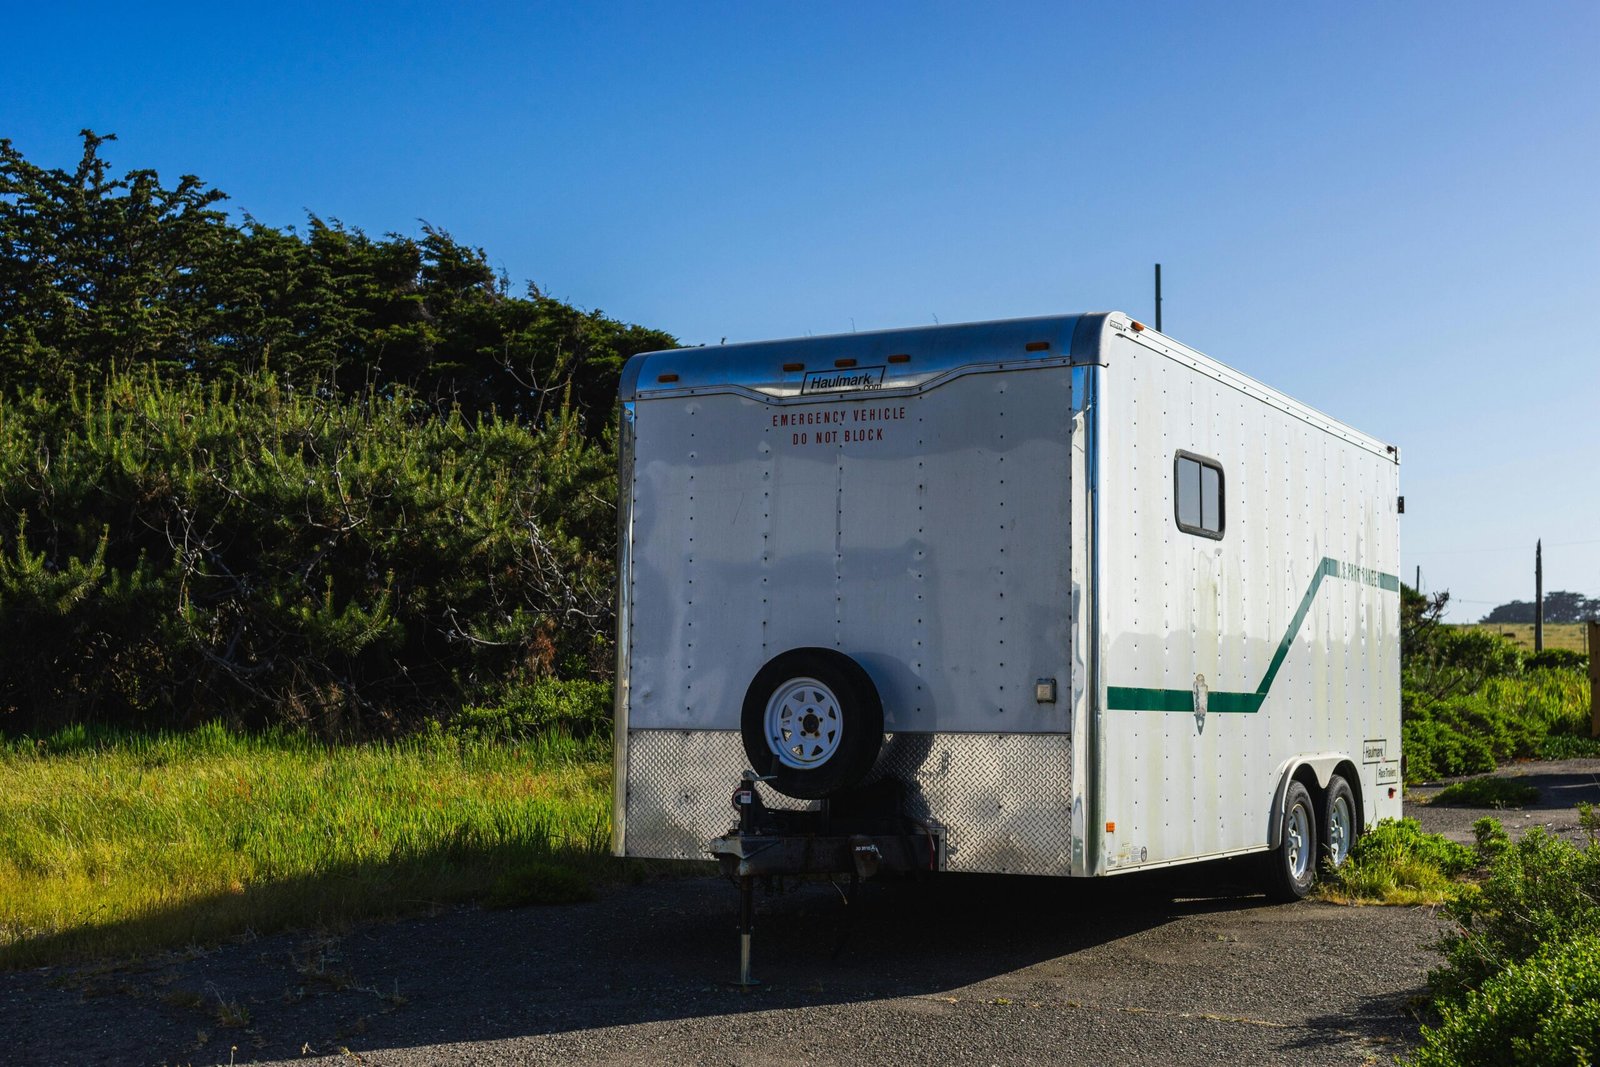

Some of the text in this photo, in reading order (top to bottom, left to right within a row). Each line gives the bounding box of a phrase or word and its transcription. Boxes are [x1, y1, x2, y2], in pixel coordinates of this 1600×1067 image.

[810, 373, 871, 389] Haulmark
[772, 407, 905, 426] EMERGENCY VEHICLE
[793, 428, 883, 445] DO NOT BLOCK
[1366, 746, 1383, 758] Haulmark
